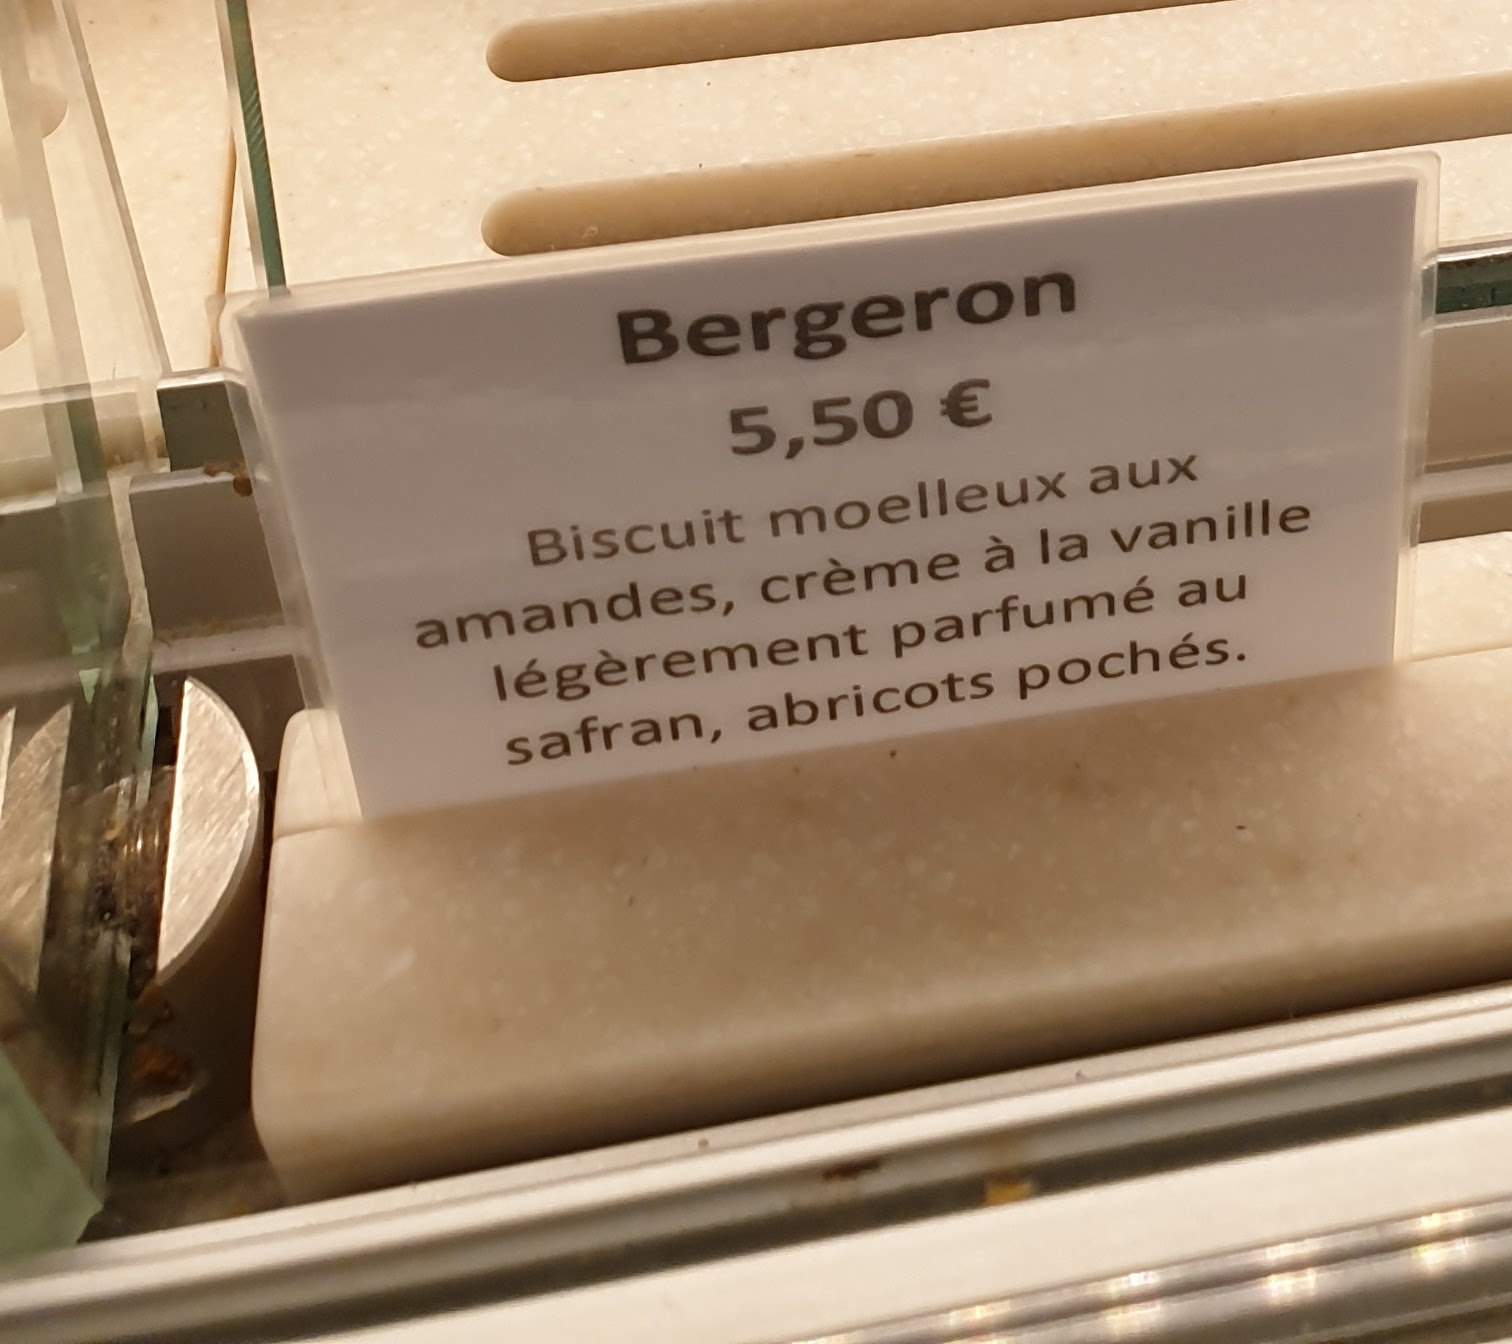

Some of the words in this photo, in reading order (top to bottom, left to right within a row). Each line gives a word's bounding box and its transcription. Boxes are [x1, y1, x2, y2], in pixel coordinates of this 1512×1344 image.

[616, 269, 1076, 365] Bergeron
[730, 390, 913, 459] 5,50
[940, 379, 992, 428] €
[528, 510, 744, 566] Biscuit
[770, 472, 1066, 537] moelleux
[1090, 455, 1197, 494] aux
[416, 582, 734, 648] amandes,
[761, 553, 960, 603] crème
[985, 536, 1014, 573] à
[1040, 529, 1088, 564] la
[1111, 499, 1310, 552] vanille
[493, 625, 868, 701] légèrement
[893, 576, 1154, 658] parfumé
[1178, 575, 1246, 607] au
[507, 714, 721, 765] safran,
[748, 673, 994, 731] abricots
[1019, 632, 1245, 700] pochés.
